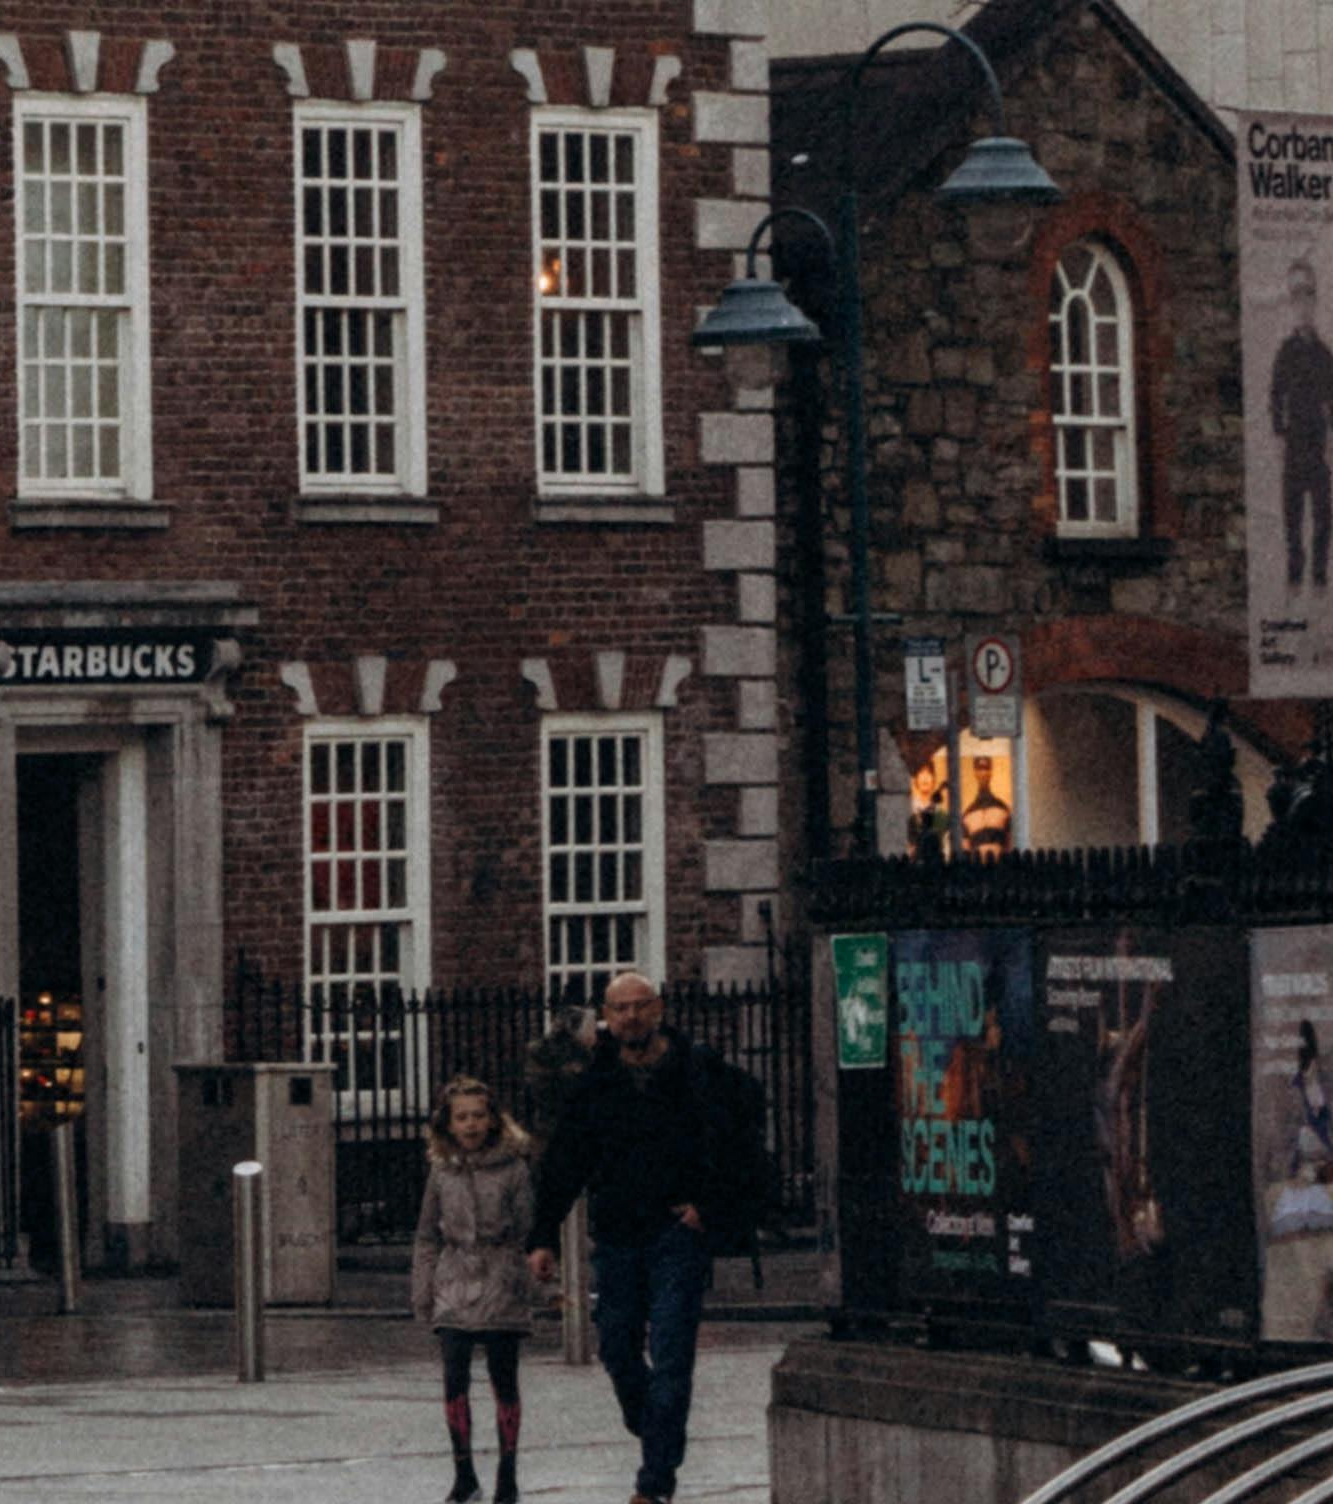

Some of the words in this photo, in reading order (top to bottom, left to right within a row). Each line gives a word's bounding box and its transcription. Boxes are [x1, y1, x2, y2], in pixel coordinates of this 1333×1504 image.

[1248, 123, 1333, 161] Corban
[1248, 162, 1331, 200] Walker
[897, 960, 984, 1037] BEHIND
[900, 1039, 946, 1114] THE
[901, 1119, 995, 1196] SCENES
